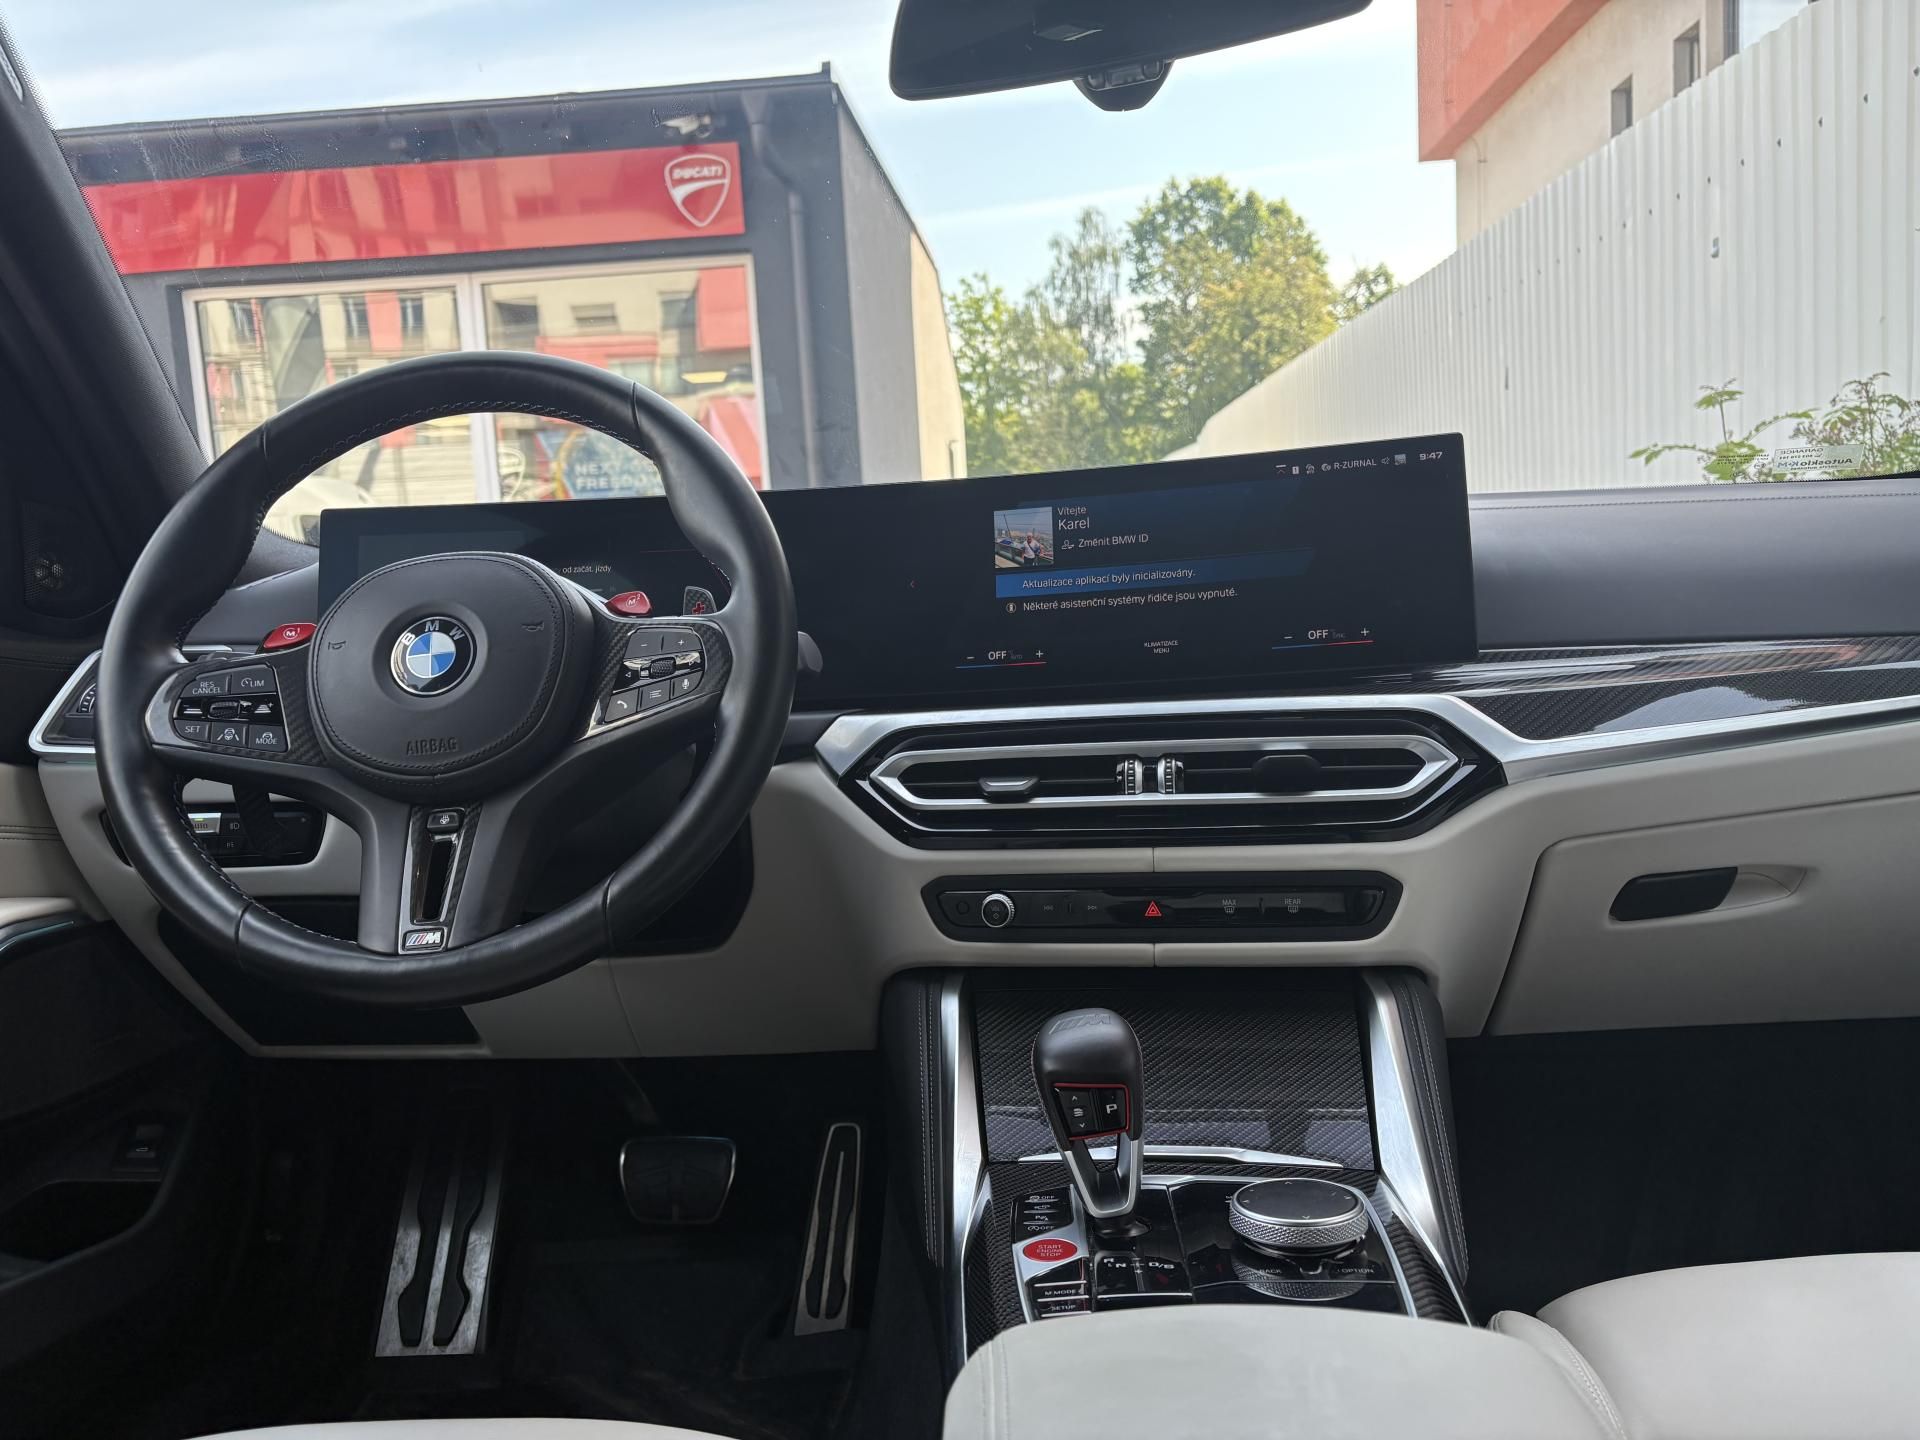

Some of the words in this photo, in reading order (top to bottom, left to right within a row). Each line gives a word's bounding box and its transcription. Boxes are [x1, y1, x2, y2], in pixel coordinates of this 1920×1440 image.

[672, 165, 723, 180] DUCATI
[1419, 451, 1443, 461] 9:47
[1058, 517, 1090, 530] Karel
[1078, 537, 1111, 548] Změnit
[1112, 534, 1136, 545] BMW
[1138, 533, 1149, 543] ID
[562, 565, 572, 574] od
[1022, 578, 1073, 589] Aktualizace
[1075, 575, 1110, 587] aplikací
[1111, 573, 1130, 584] byly
[1132, 568, 1196, 580] inicializovány.
[1023, 601, 1058, 611] Některé
[1060, 596, 1106, 609] asistenční
[1108, 594, 1145, 607] systémy
[1175, 590, 1195, 603] jsou
[1197, 587, 1238, 600] vypnuté.
[401, 619, 466, 646] BMW
[1308, 629, 1329, 640] OFF
[988, 650, 1007, 661] OFF
[250, 679, 265, 687] LIM
[192, 687, 222, 695] CANCEL
[185, 725, 201, 733] SET
[255, 737, 278, 745] MODE
[405, 736, 458, 756] AIRBAG
[1222, 898, 1237, 906] MAX
[1284, 897, 1302, 905] REAR
[1106, 1103, 1118, 1114] P
[1051, 1304, 1076, 1312] SETUP
